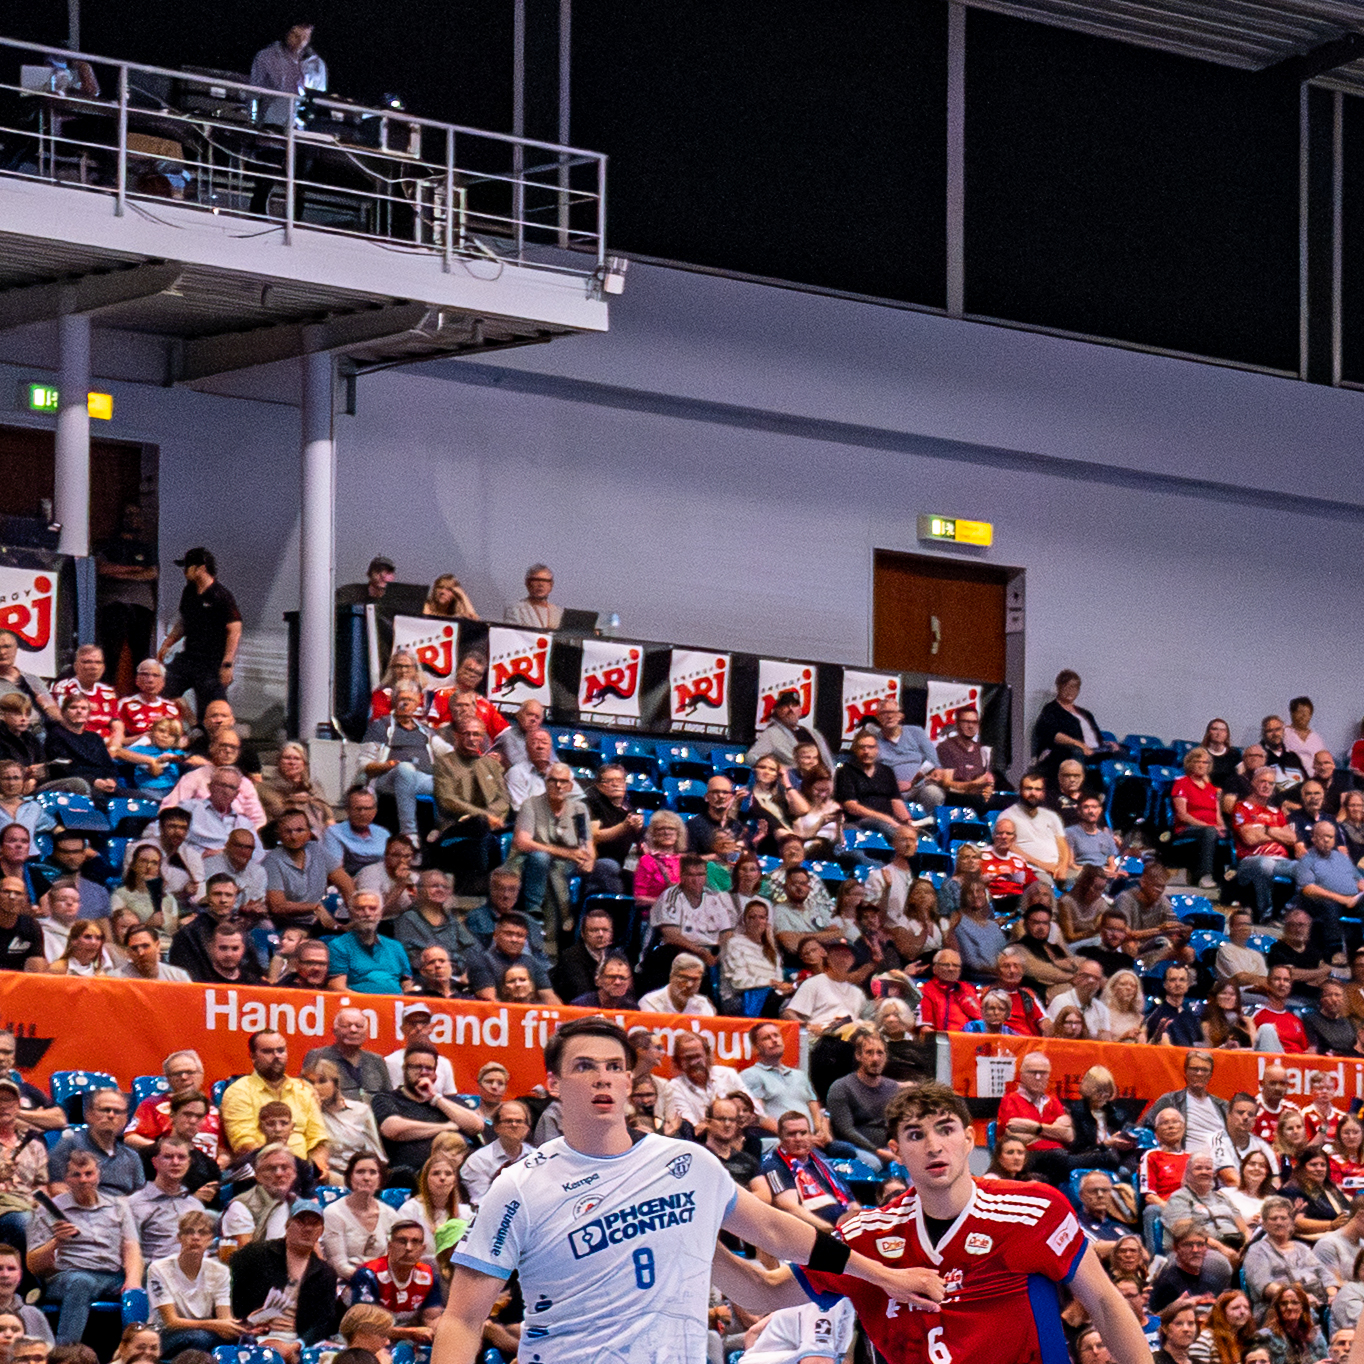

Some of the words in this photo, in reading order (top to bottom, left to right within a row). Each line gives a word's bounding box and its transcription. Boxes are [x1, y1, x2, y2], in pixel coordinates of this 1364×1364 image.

[760, 668, 812, 723] NJ
[204, 988, 325, 1038] Hand
[521, 1010, 560, 1048] fü
[562, 1172, 600, 1192] Kempa
[490, 1199, 521, 1257] animonda
[608, 1206, 696, 1245] CONTACT
[632, 1247, 655, 1290] 8
